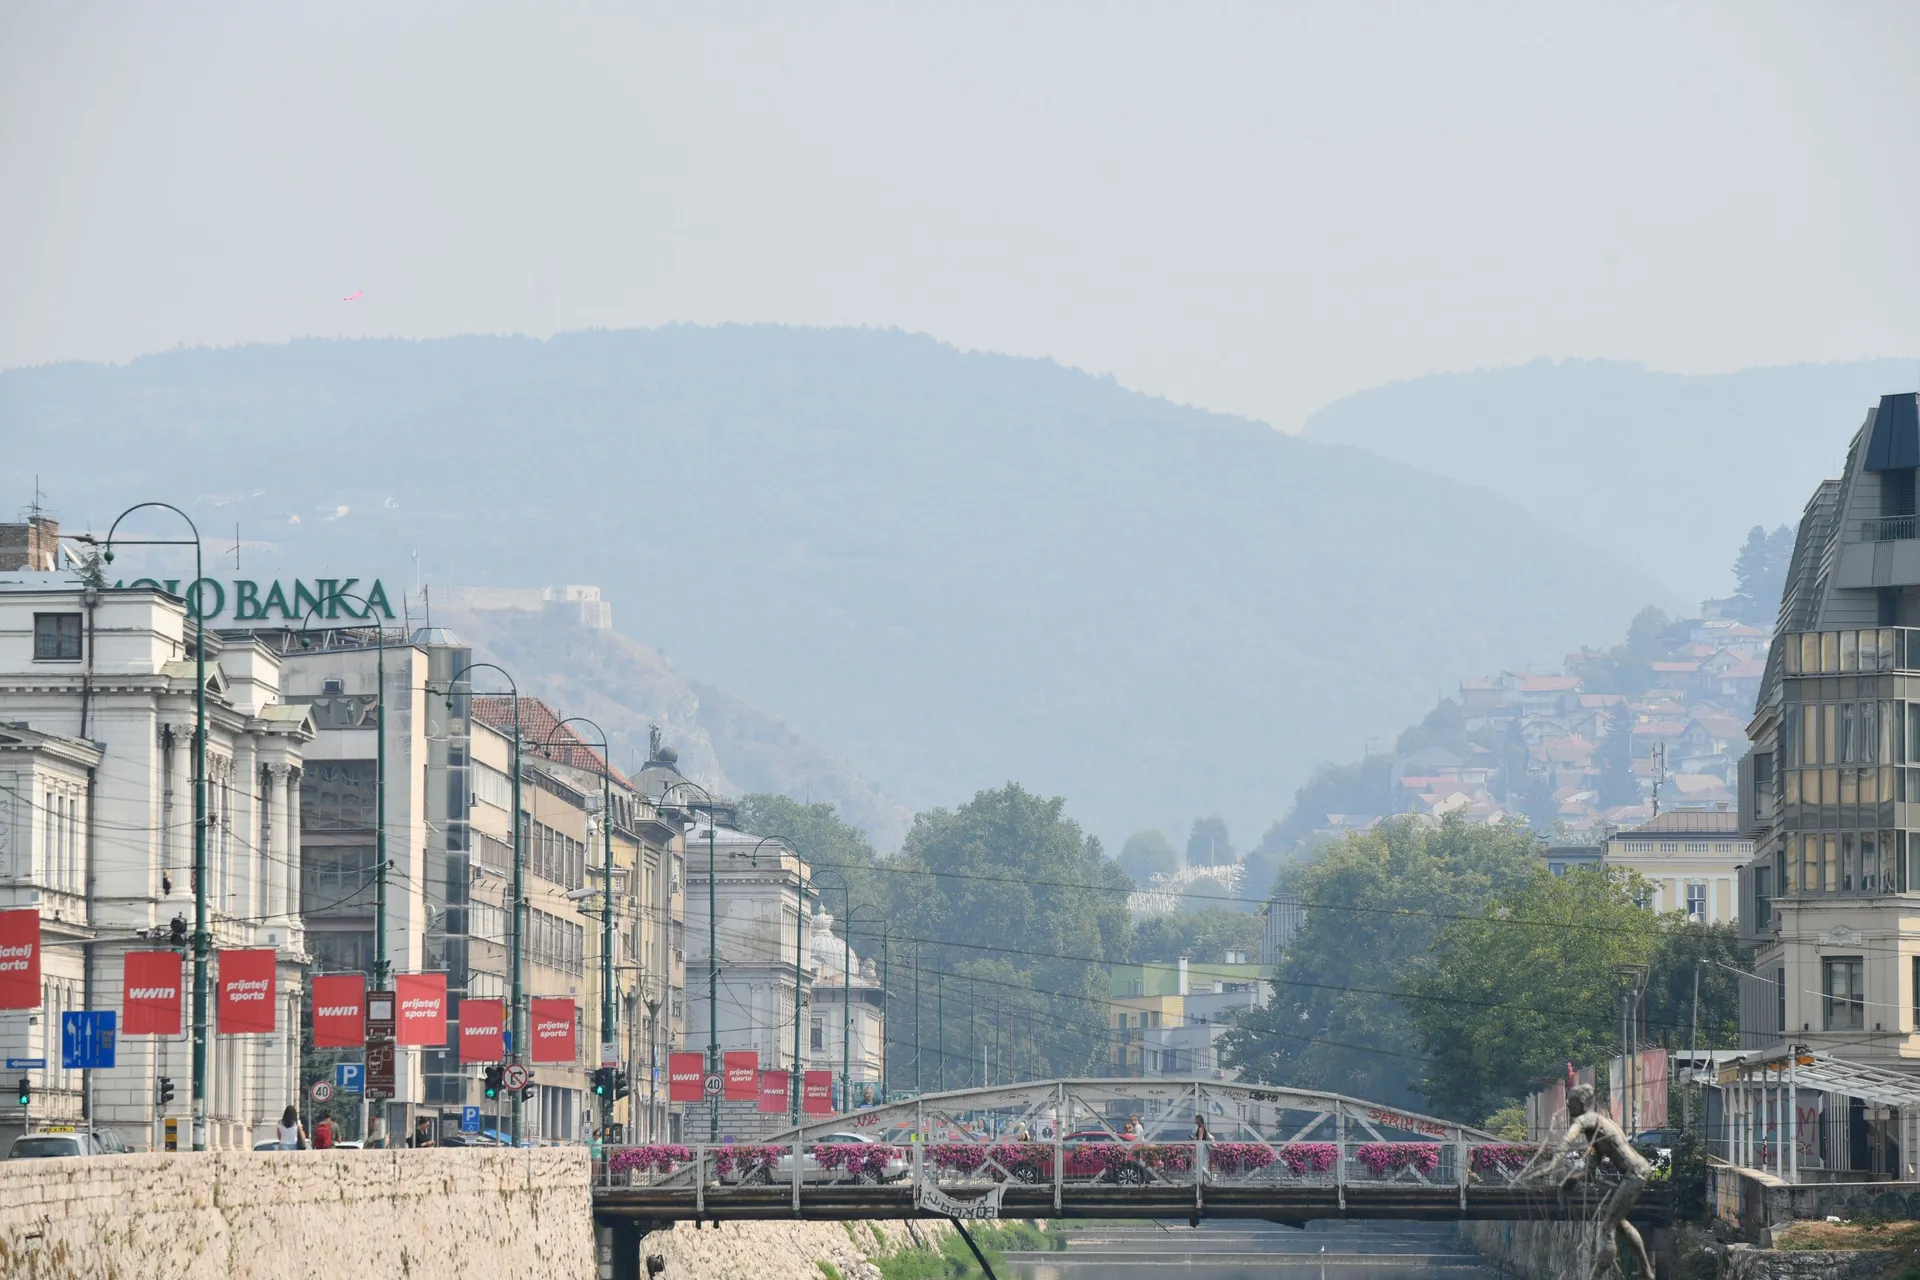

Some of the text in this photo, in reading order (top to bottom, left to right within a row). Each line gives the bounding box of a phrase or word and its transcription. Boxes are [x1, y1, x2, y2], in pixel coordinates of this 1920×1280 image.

[233, 578, 396, 620] BANKA
[227, 979, 269, 991] prijatelj
[230, 991, 266, 1002] sporta
[402, 998, 441, 1010] prijatelj
[405, 1009, 437, 1019] sporta
[537, 1020, 570, 1032] prijatelj
[540, 1029, 568, 1038] sporta
[729, 1068, 754, 1077] prijatelj
[731, 1074, 752, 1082] sporta
[707, 1080, 720, 1091] 40
[806, 1085, 829, 1094] prijatelj
[315, 1086, 329, 1098] 40
